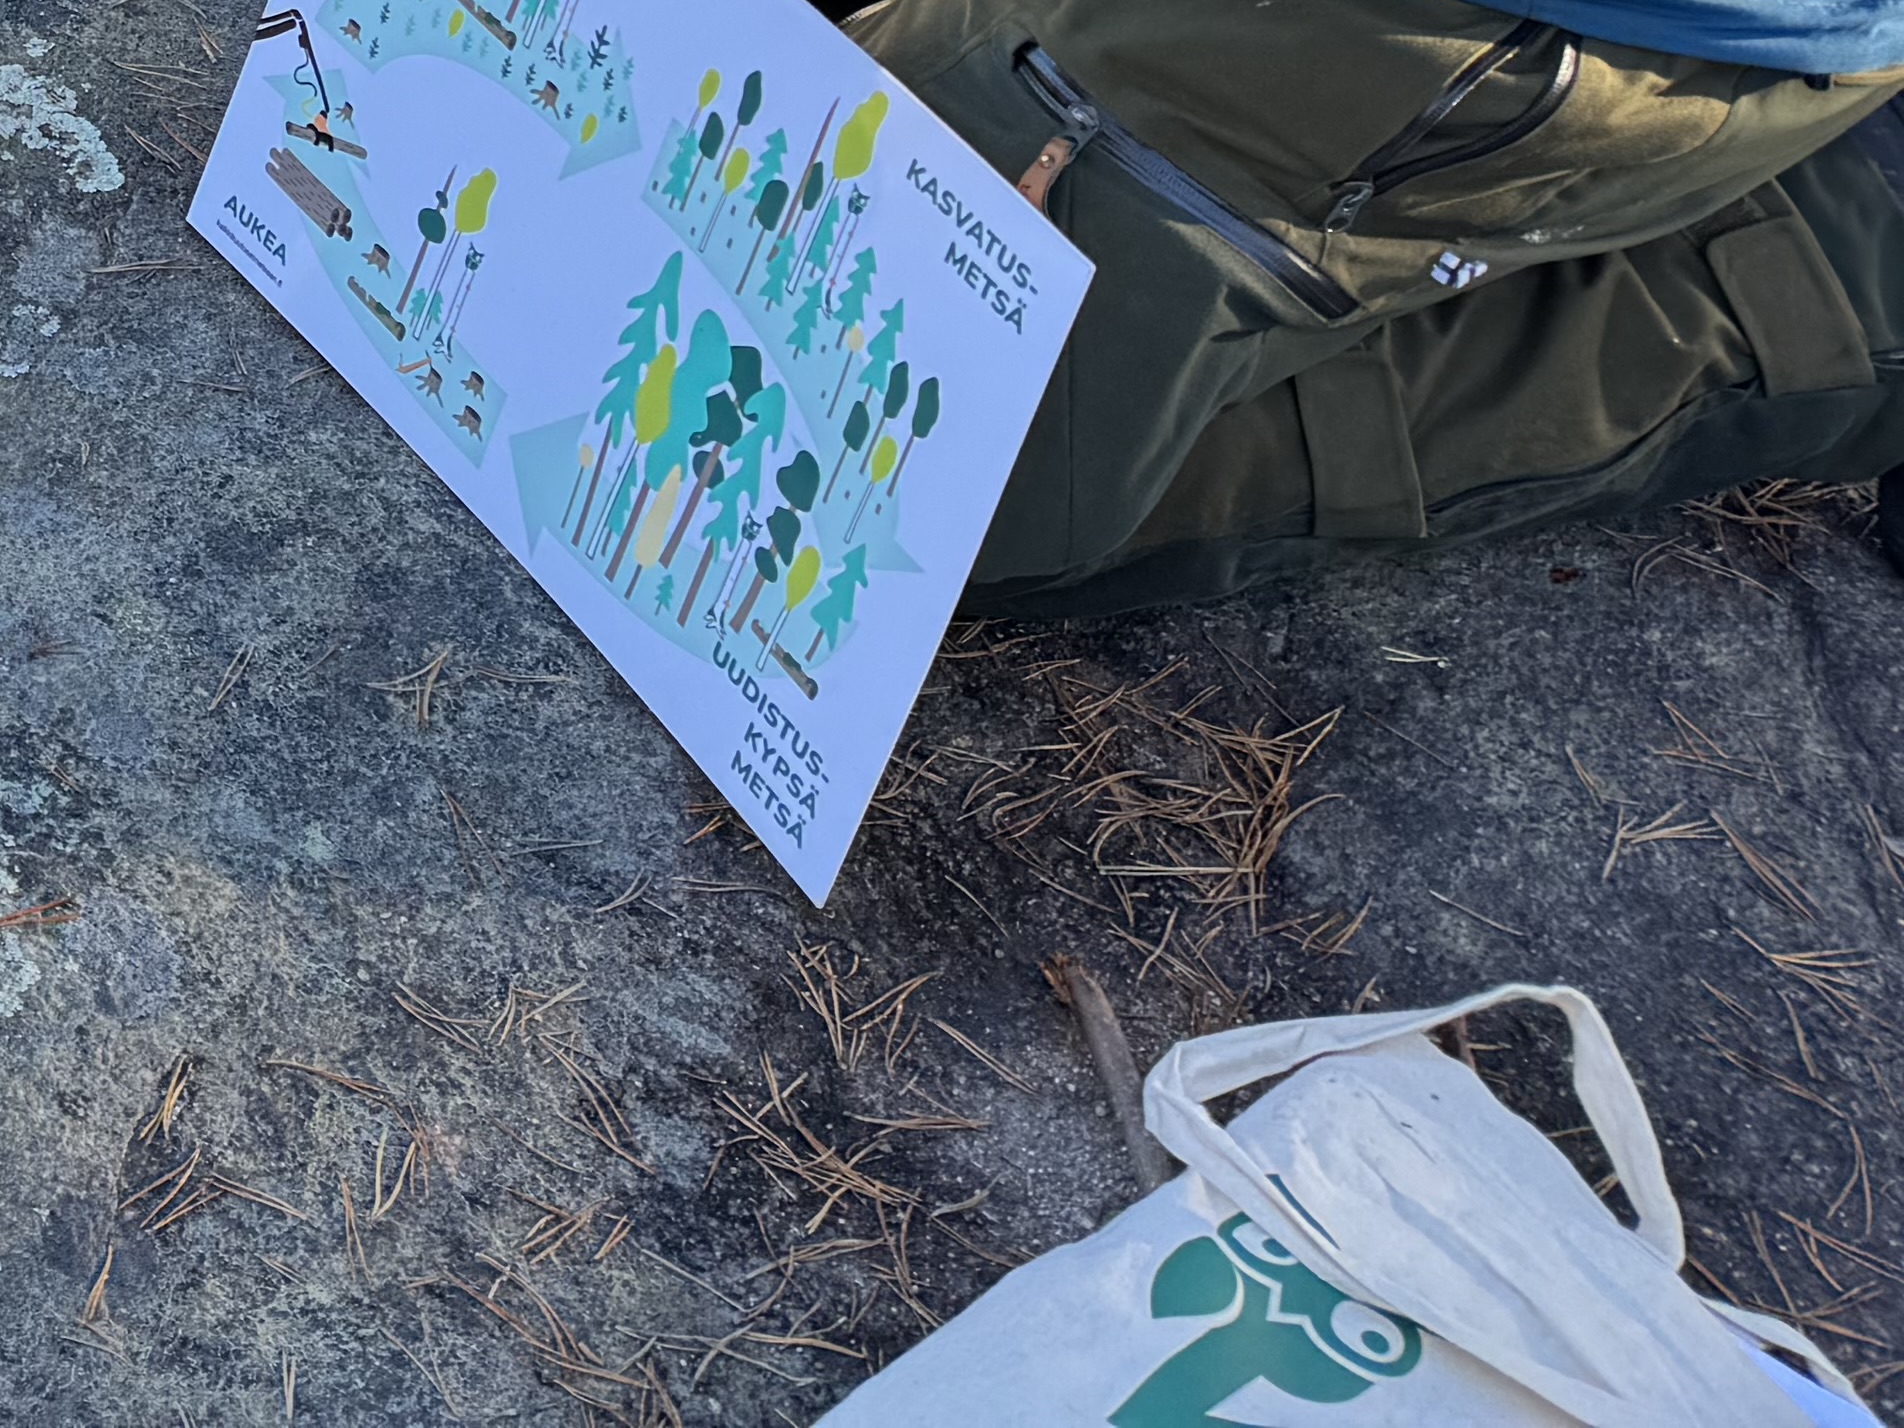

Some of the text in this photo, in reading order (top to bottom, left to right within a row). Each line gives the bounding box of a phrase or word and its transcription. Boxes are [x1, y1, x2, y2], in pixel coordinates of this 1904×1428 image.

[223, 195, 286, 266] AUKEA
[906, 158, 1039, 295] KASVATUS-
[944, 241, 1027, 335] METSÄ
[712, 641, 830, 784] UUDISTUS-
[731, 750, 806, 849] METSÄ
[744, 721, 819, 819] KYPSÄ
